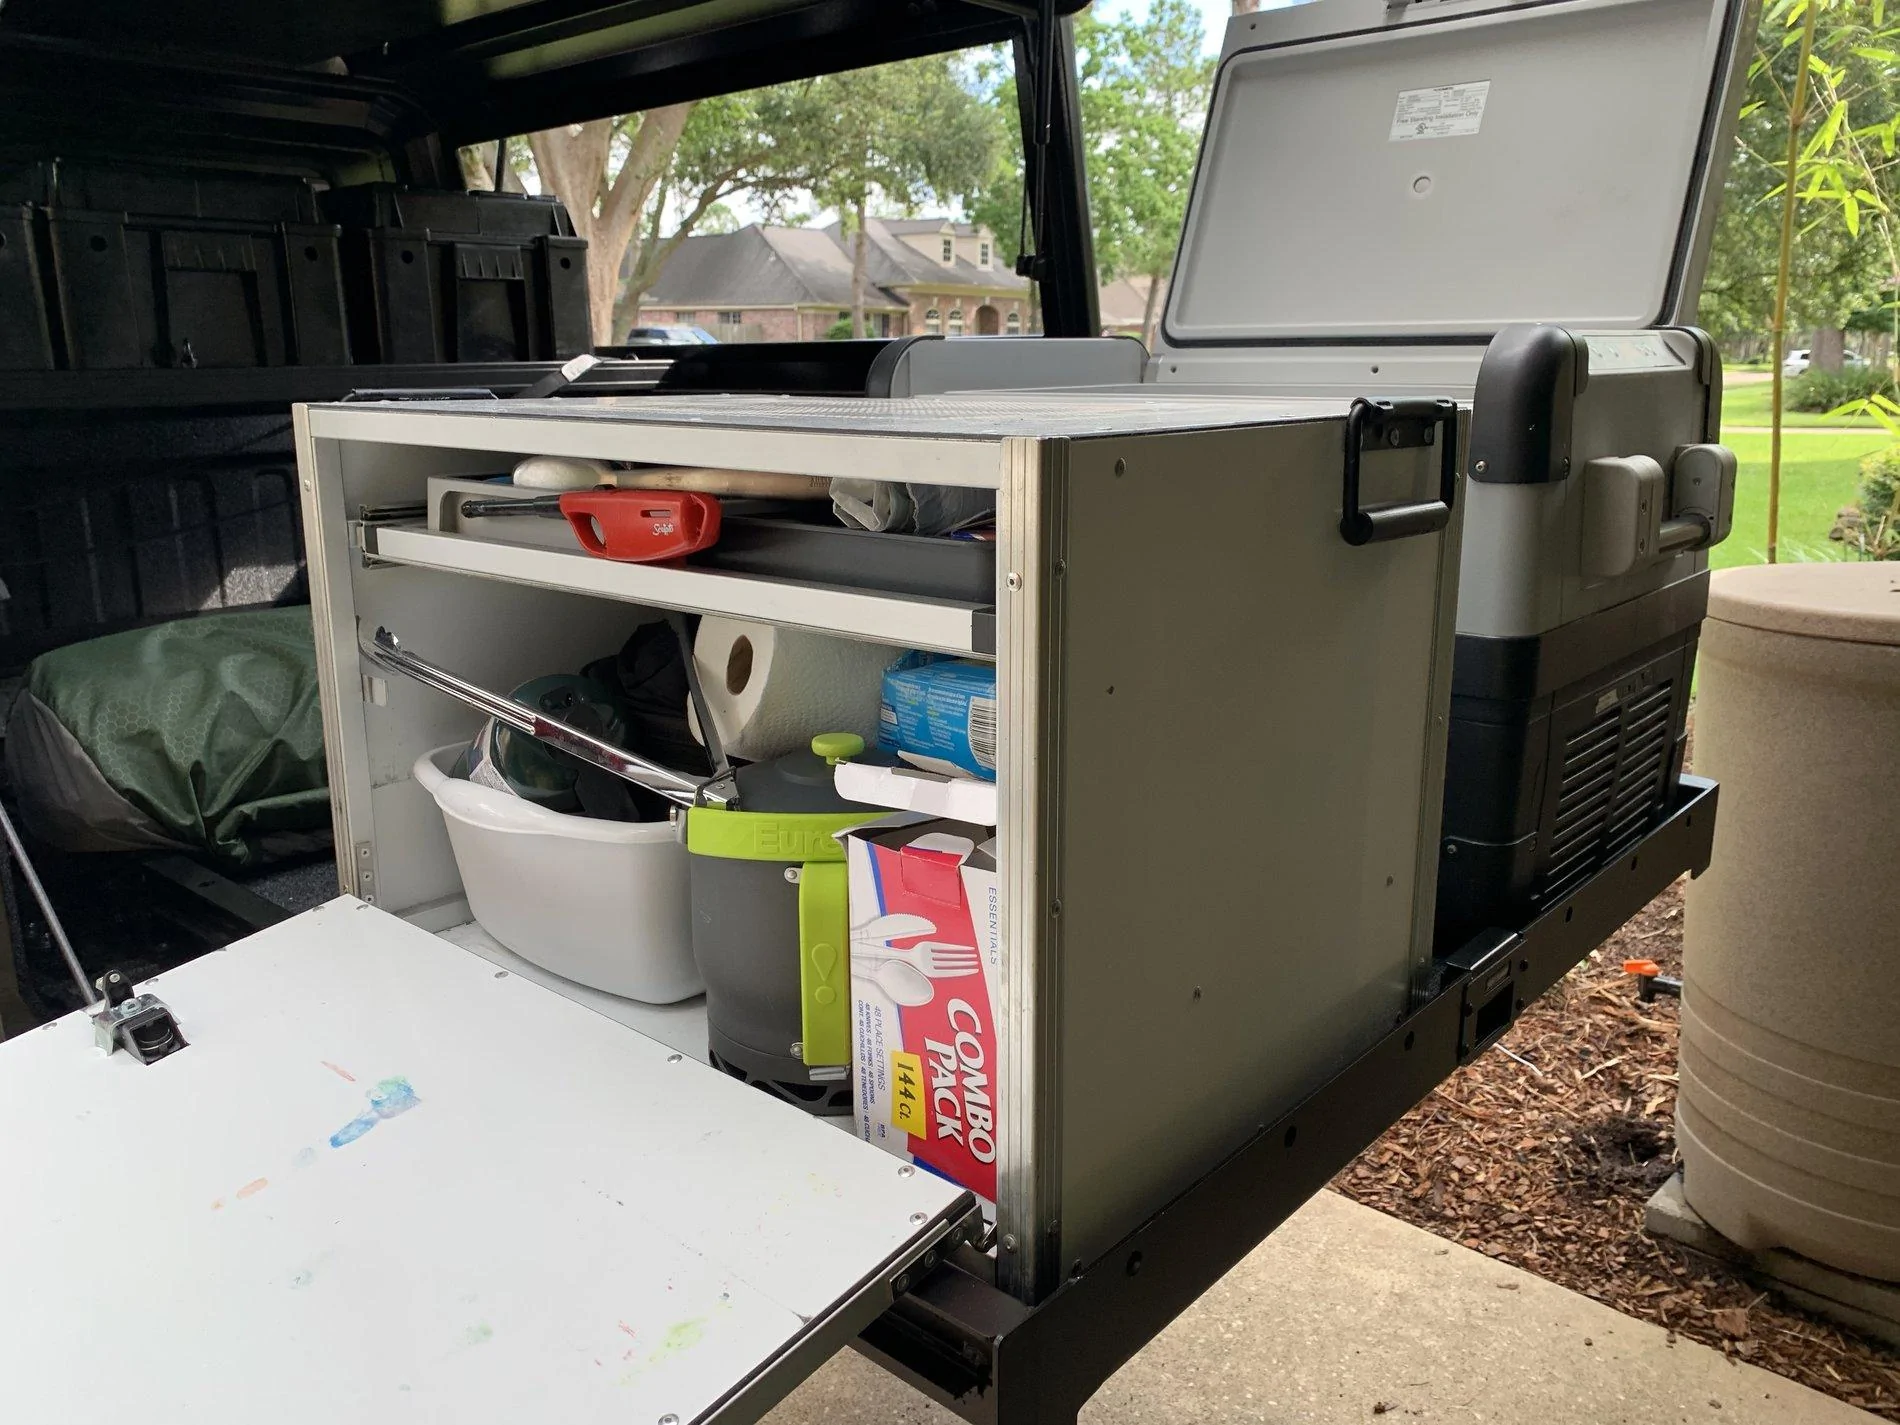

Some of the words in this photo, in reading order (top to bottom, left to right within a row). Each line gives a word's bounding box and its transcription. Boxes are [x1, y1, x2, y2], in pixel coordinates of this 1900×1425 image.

[989, 887, 997, 965] ESSENTIALS
[874, 1005, 882, 1018] 48
[875, 1018, 883, 1046] PLACE
[876, 1048, 886, 1091] SETTINGS
[897, 1061, 916, 1101] 144
[947, 998, 996, 1164] COMBO
[923, 1036, 964, 1147] PACK
